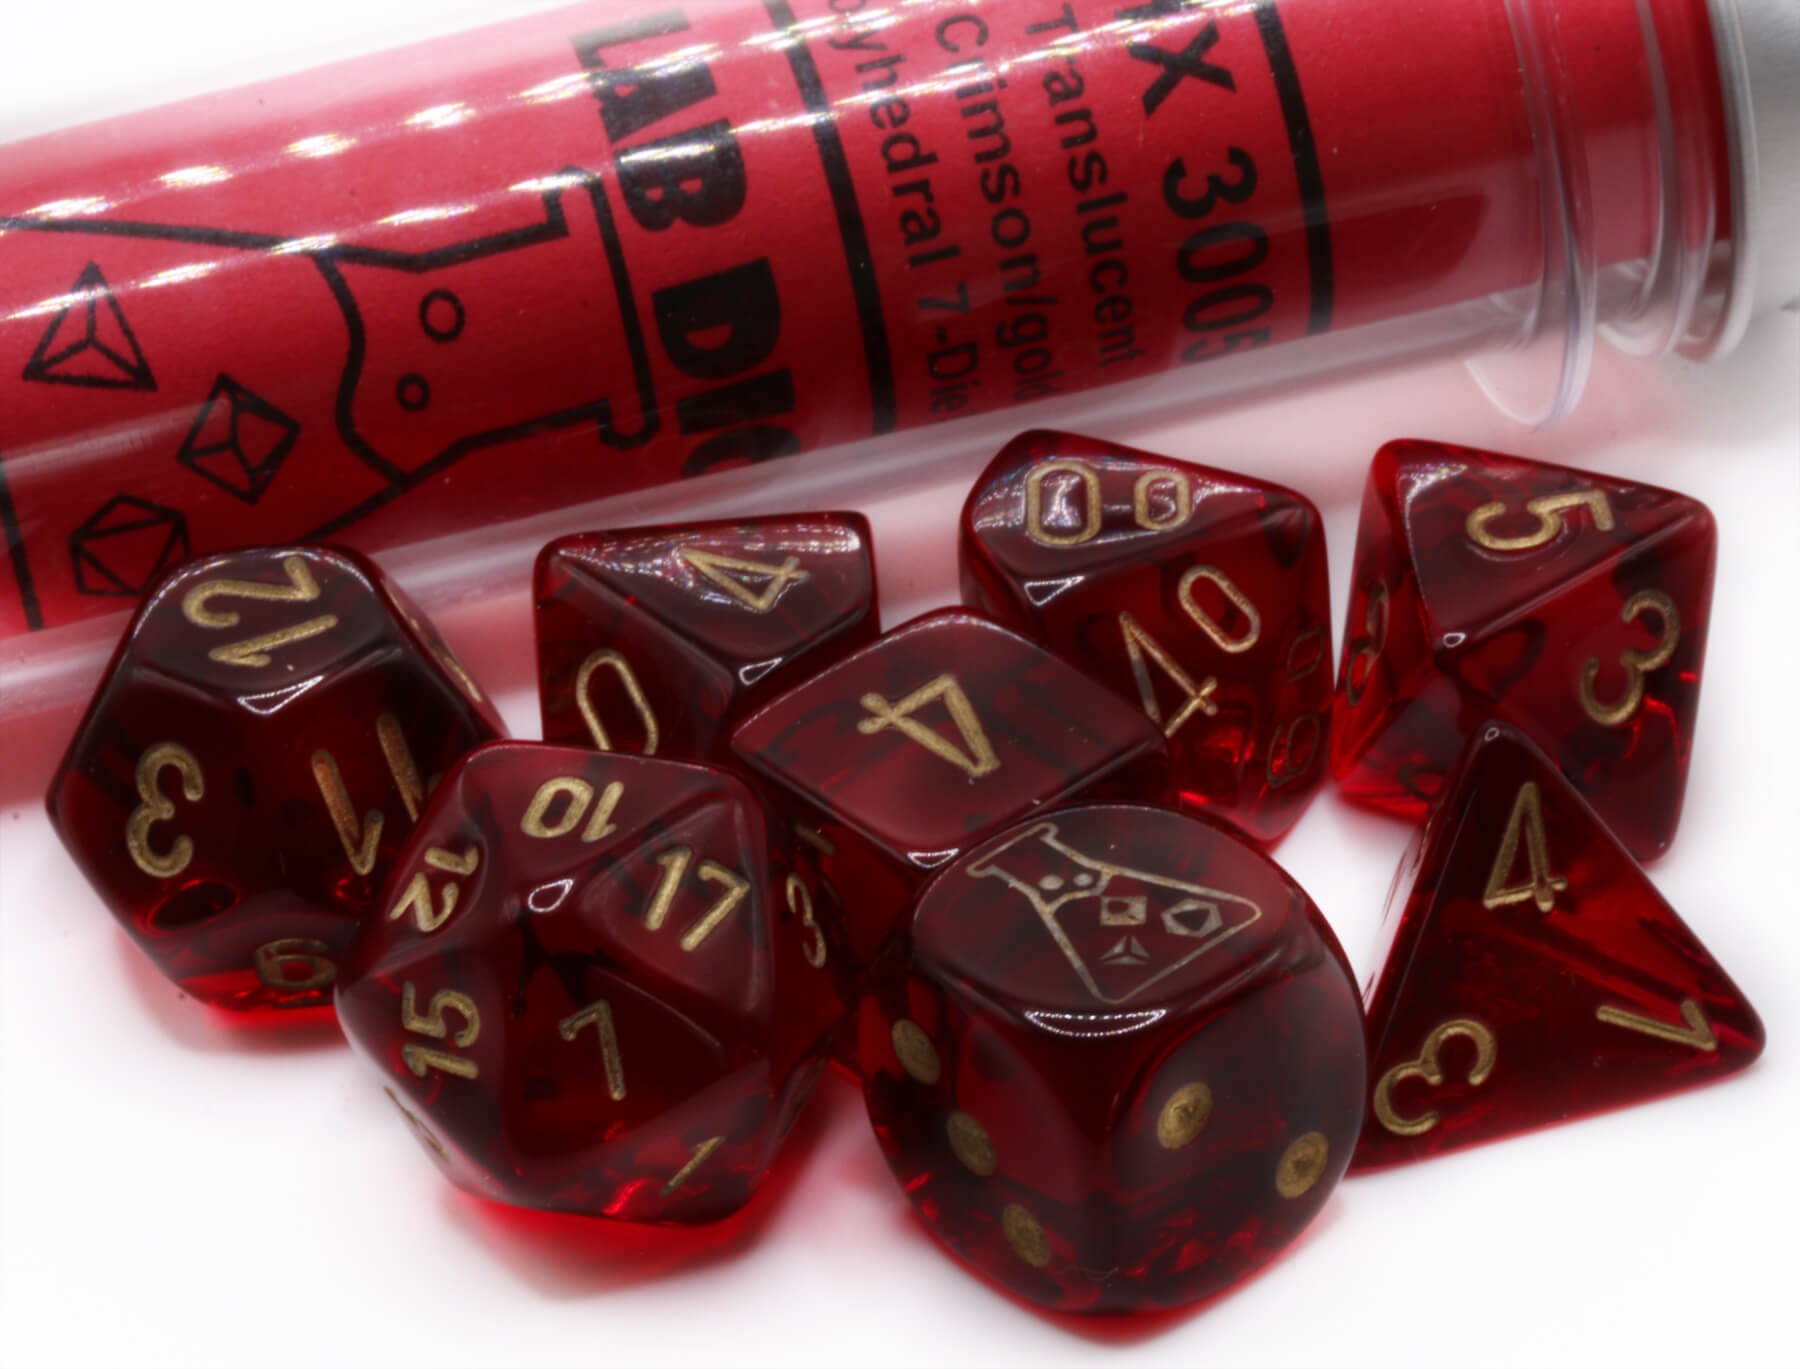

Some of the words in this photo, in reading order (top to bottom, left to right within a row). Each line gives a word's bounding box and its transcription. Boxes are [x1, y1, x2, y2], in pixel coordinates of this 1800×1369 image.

[569, 8, 746, 232] LAB
[1026, 4, 1146, 368] Tanslucent
[1162, 146, 1274, 362] 3005
[1465, 489, 1615, 551] 5
[182, 556, 339, 669] 12
[680, 547, 811, 613] 4
[1579, 589, 1682, 727] 3
[856, 673, 1001, 778] 4
[126, 741, 204, 879] 3
[1483, 781, 1568, 912] 4
[389, 845, 479, 933] 12
[644, 845, 751, 952] 17
[401, 981, 480, 1080] 15
[558, 999, 627, 1101] 7
[1373, 1019, 1496, 1136] 3
[1596, 999, 1718, 1051] 1
